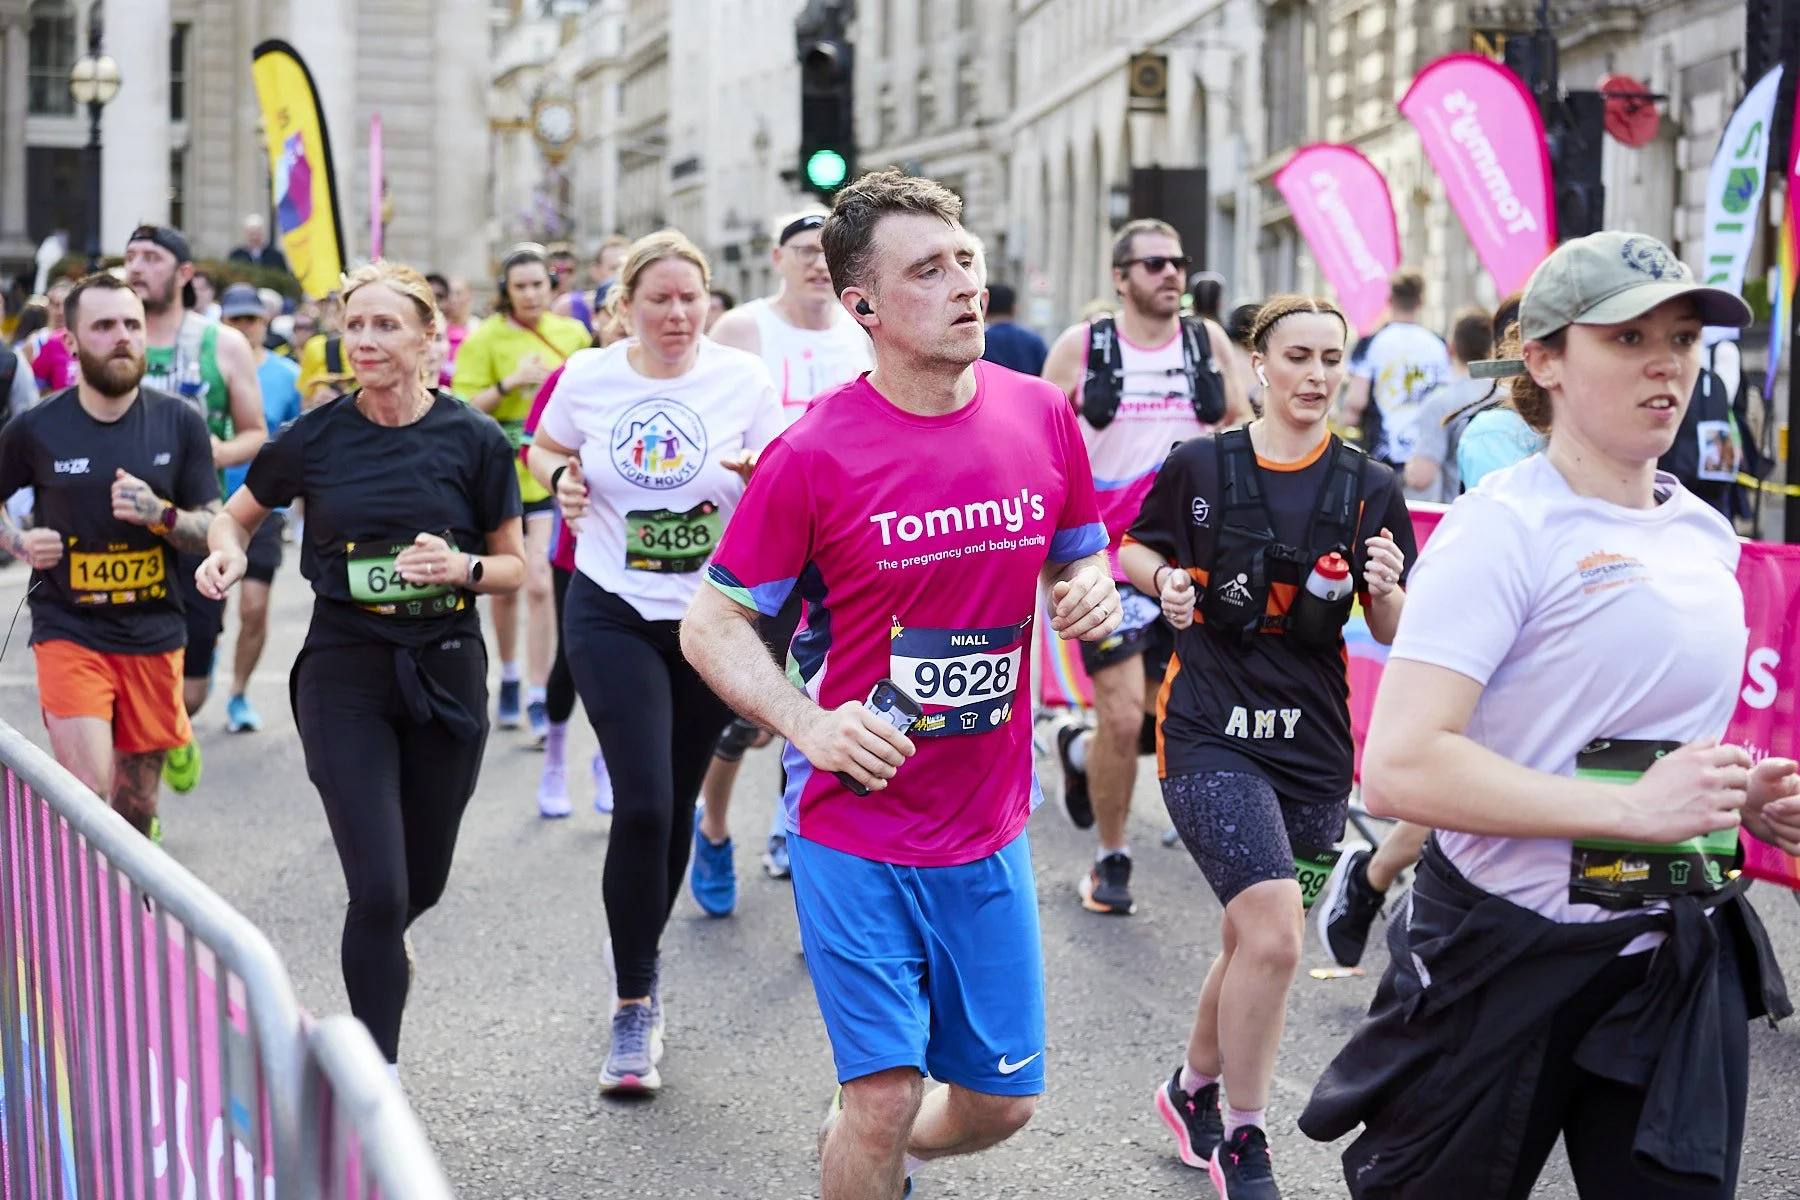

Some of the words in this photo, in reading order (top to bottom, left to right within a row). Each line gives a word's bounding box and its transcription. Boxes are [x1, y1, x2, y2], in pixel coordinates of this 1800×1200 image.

[620, 459, 651, 485] HOPE
[654, 461, 696, 487] HOUSE
[869, 488, 1045, 546] Tommy's
[639, 524, 710, 551] 6488
[876, 560, 898, 571] The
[901, 547, 962, 569] pregnancy
[964, 541, 986, 554] and
[989, 537, 1017, 551] baby
[1018, 533, 1046, 547] charity
[77, 555, 160, 582] 14073
[367, 566, 450, 594] 64
[950, 634, 989, 646] NIALL
[914, 656, 1011, 699] 9628
[1224, 705, 1302, 739] AMY
[1295, 866, 1327, 898] 89
